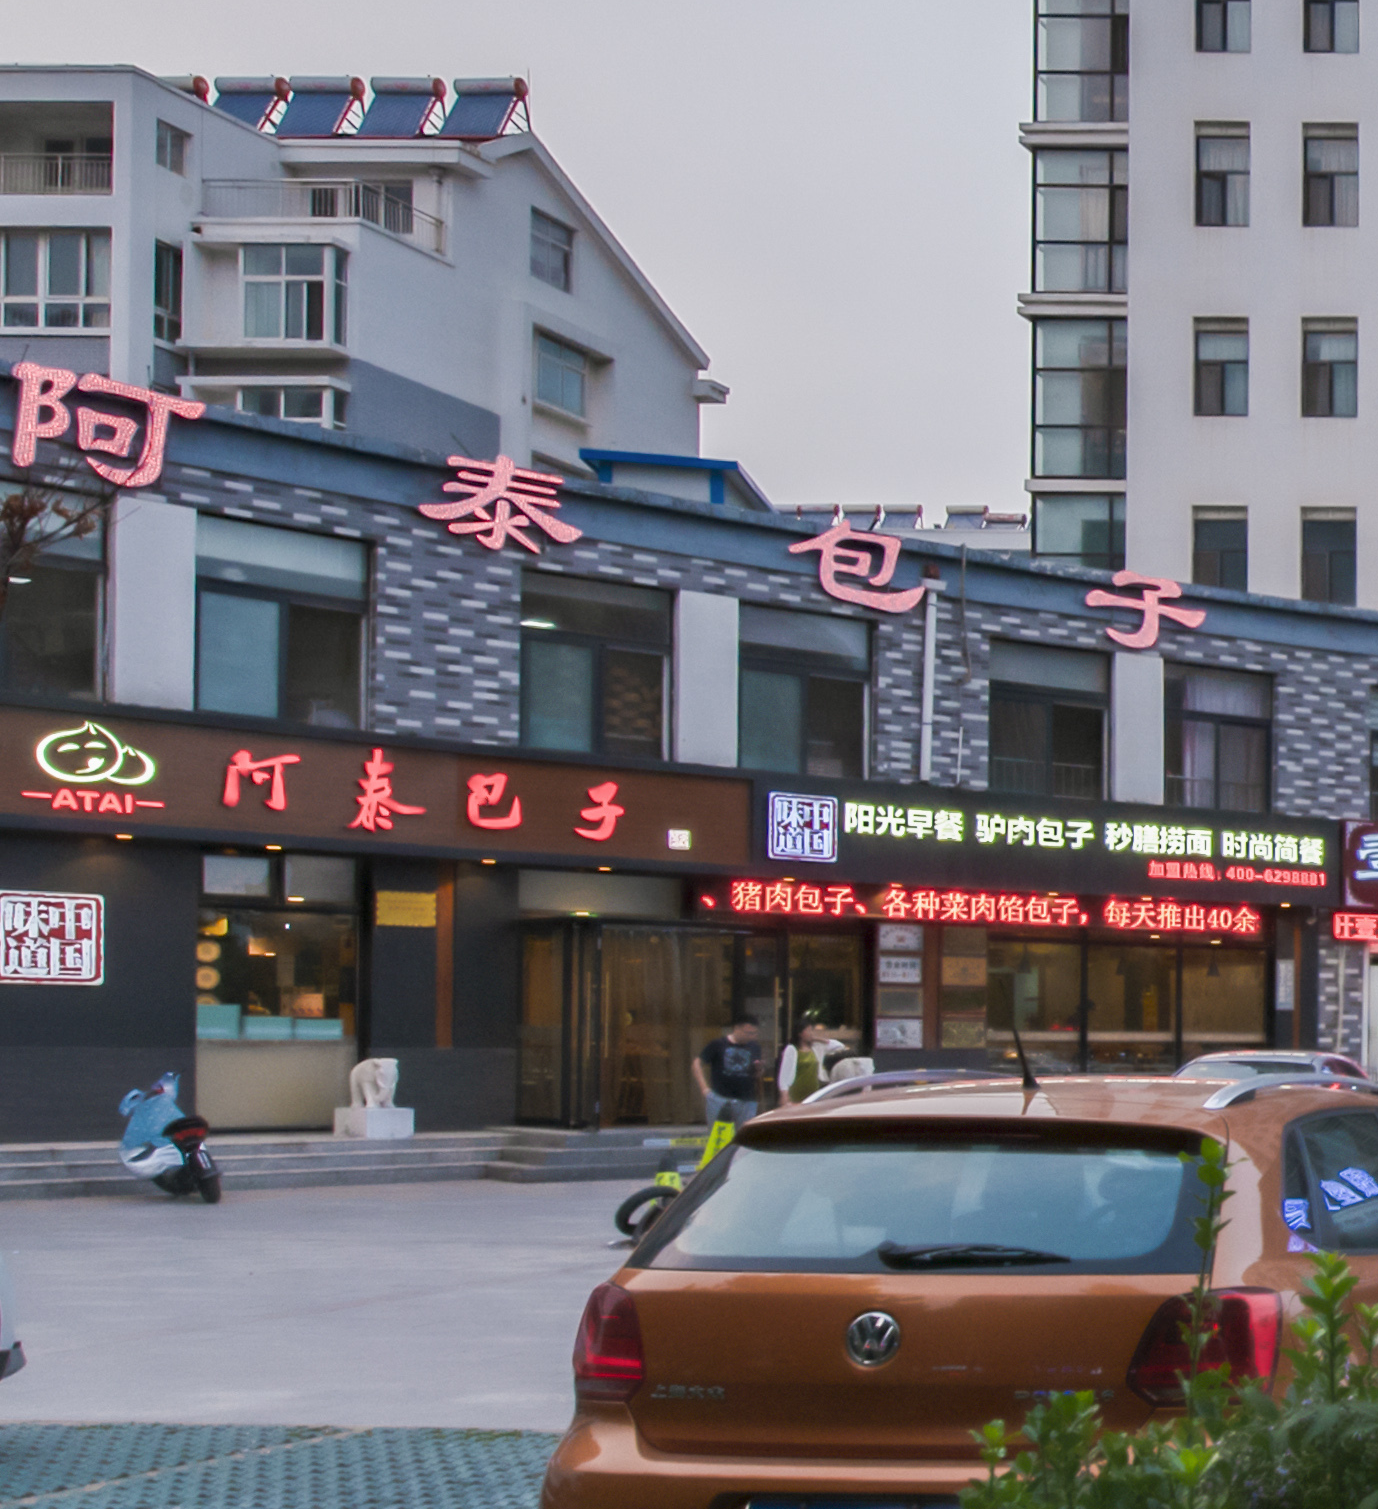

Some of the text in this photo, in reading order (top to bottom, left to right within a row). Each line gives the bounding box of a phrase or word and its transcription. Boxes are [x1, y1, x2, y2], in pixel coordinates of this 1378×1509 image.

[51, 788, 135, 815] ATAI
[843, 801, 964, 843] 阳光早餐
[975, 813, 1095, 850] 驴肉包子
[1221, 831, 1325, 867] 时尚简餐
